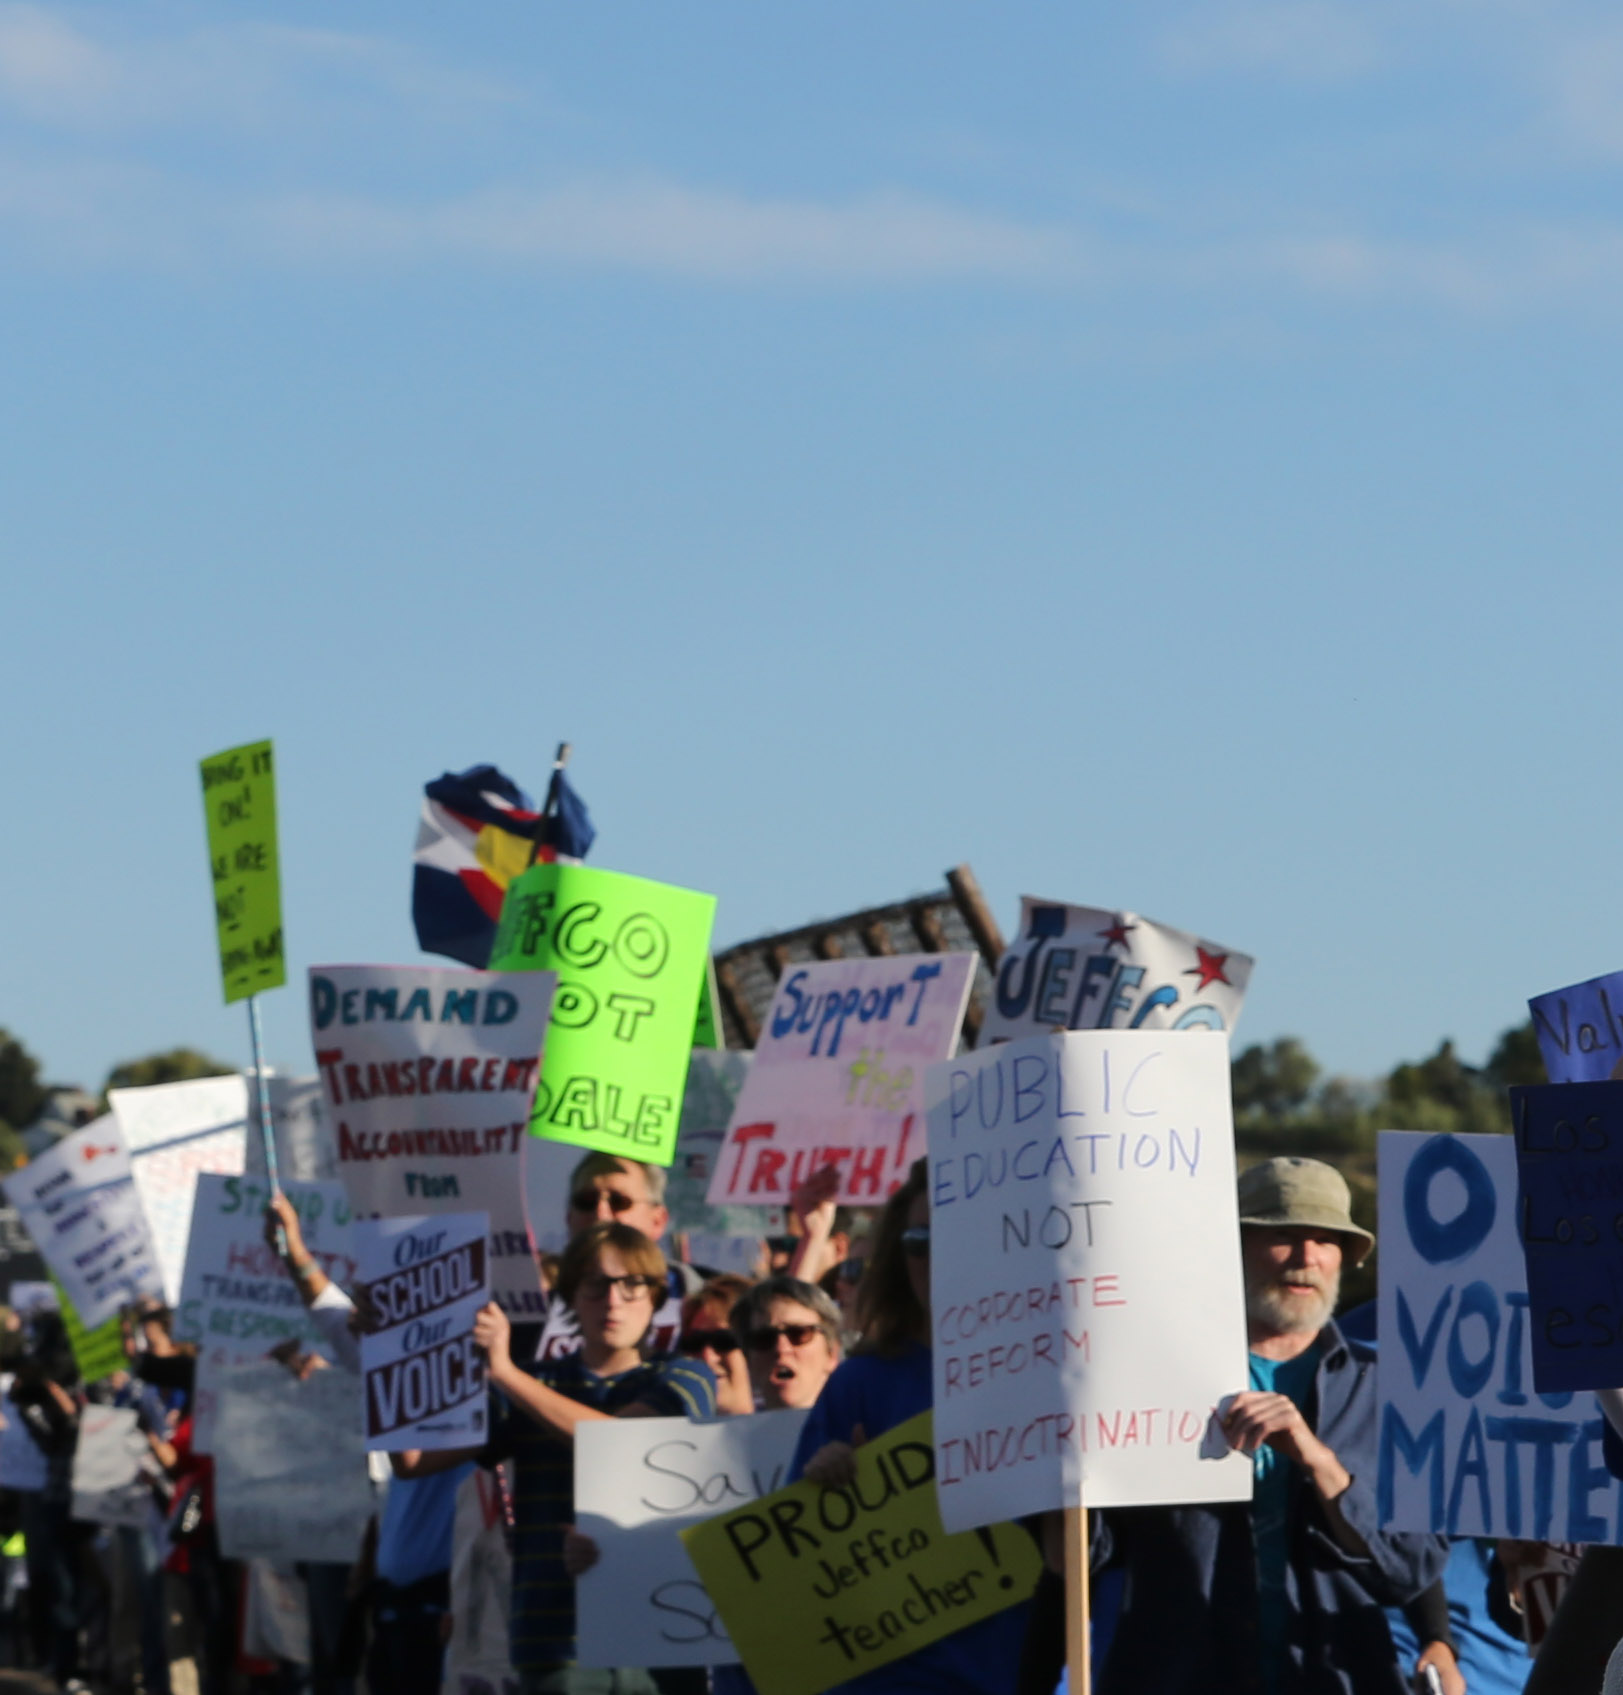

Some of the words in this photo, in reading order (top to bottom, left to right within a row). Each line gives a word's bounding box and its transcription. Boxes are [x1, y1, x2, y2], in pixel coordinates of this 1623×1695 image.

[311, 974, 519, 1031] DEMAND
[550, 981, 655, 1043] OT
[950, 1048, 1163, 1139] PUBLIC
[933, 1126, 1202, 1207] EDUCATION
[394, 1229, 448, 1268] Our
[1002, 1200, 1112, 1253] NOT
[371, 1247, 479, 1328] SCHOOL
[940, 1274, 1127, 1346] CORPORATE
[403, 1318, 452, 1352] Our
[945, 1329, 1092, 1398] REFORM
[371, 1335, 482, 1433] VOICE
[640, 1440, 784, 1514] Sav
[723, 1442, 935, 1582] PROUD
[813, 1527, 930, 1600] Jeffco
